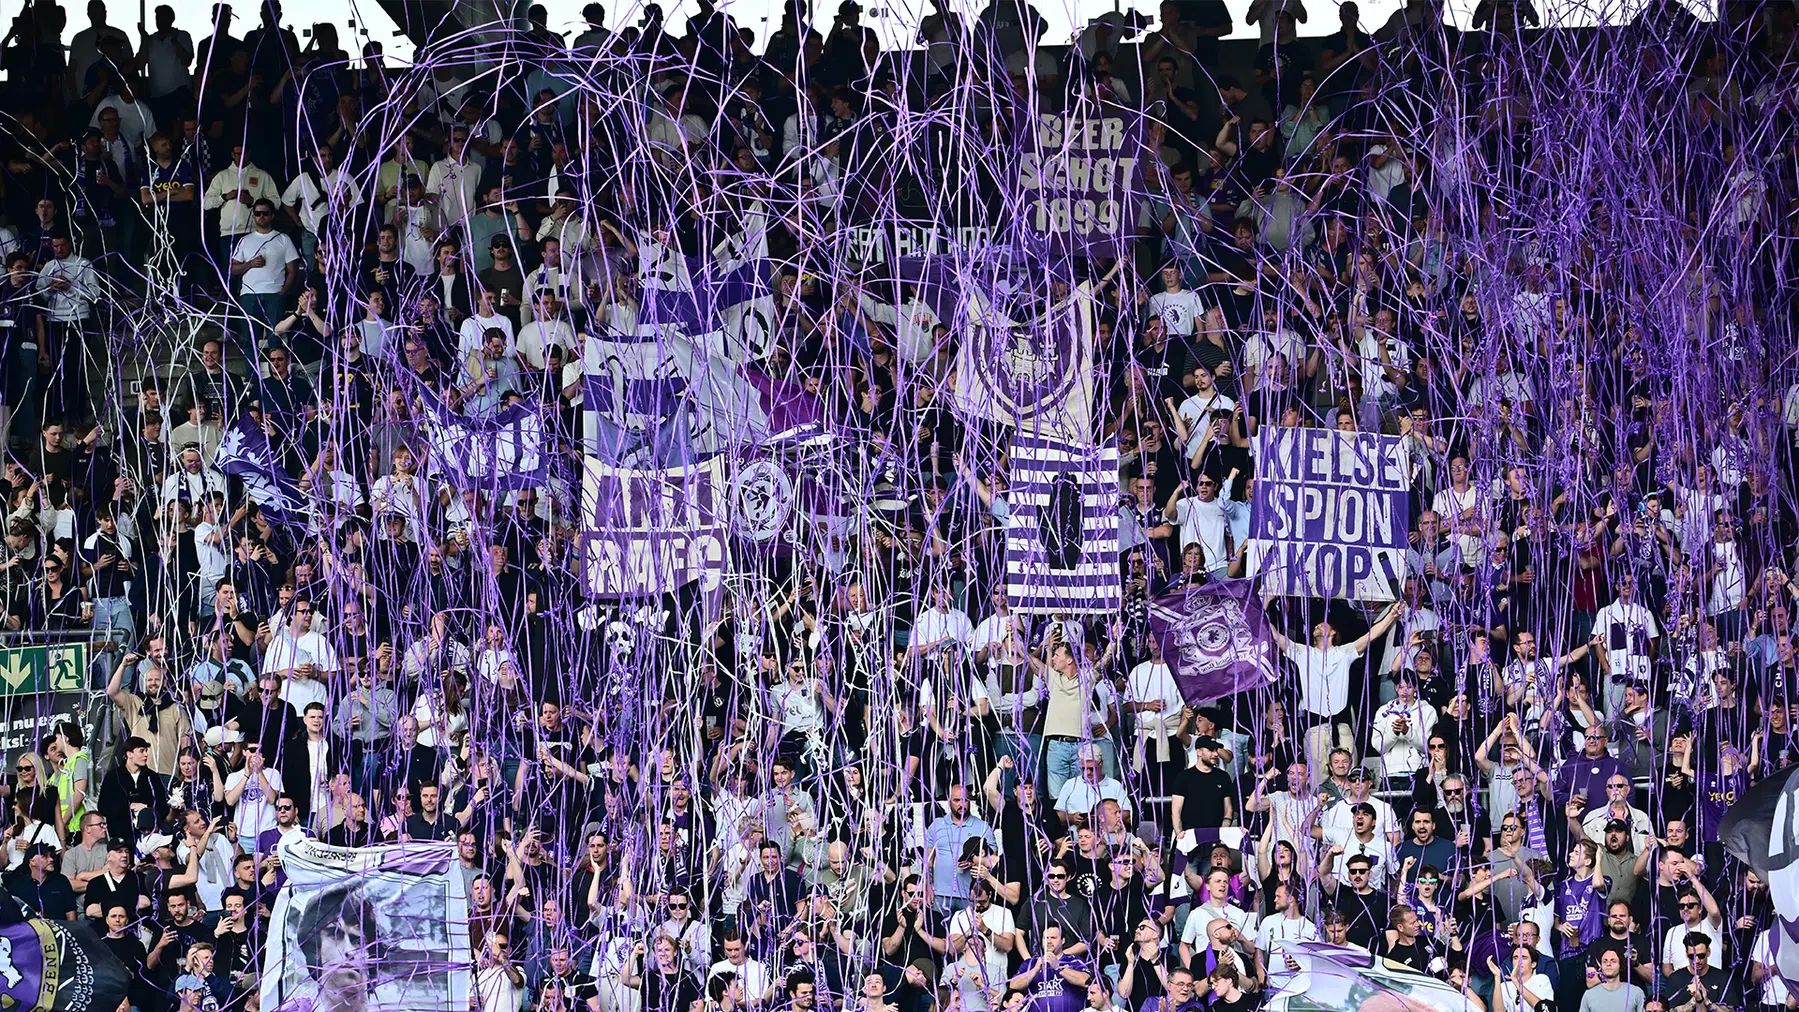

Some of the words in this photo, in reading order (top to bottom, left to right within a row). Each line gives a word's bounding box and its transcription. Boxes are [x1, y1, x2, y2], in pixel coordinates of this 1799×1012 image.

[1040, 113, 1124, 150] BEER
[1020, 152, 1139, 193] SCHOT
[1032, 198, 1120, 235] 1899
[1259, 427, 1401, 487] KIELSE
[1267, 484, 1393, 544] SPION
[1285, 543, 1373, 599] KOP
[44, 943, 57, 996] BENE
